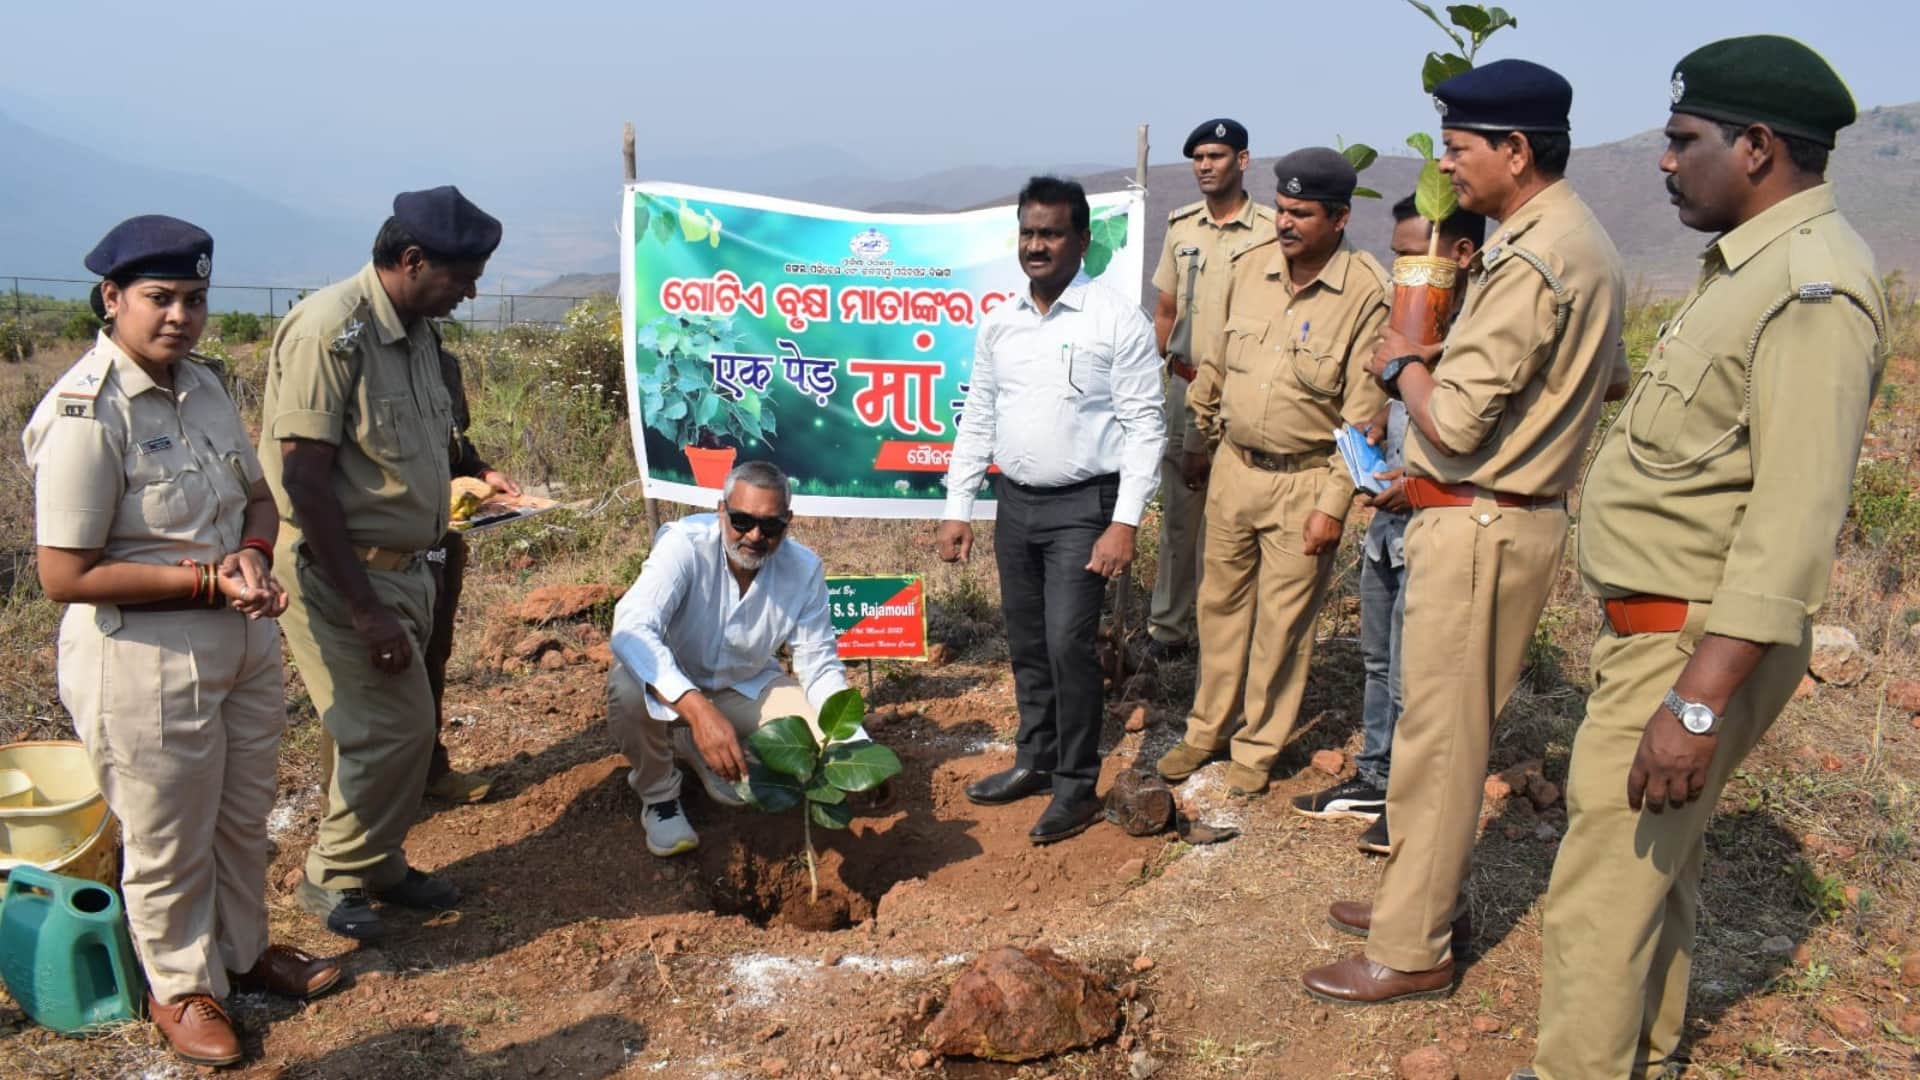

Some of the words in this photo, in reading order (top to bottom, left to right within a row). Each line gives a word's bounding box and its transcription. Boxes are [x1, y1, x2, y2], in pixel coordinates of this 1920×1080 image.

[662, 272, 765, 317] ଗୋଟିଏ
[774, 285, 829, 331] ବୃକ୍ଷ
[840, 288, 974, 325] ମାତାଙ୍କର
[710, 353, 775, 399] एक
[778, 339, 838, 405] पेड़
[848, 332, 944, 434] मां
[833, 602, 845, 617] S.
[847, 602, 859, 617] S.
[861, 600, 915, 620] Rajamouli
